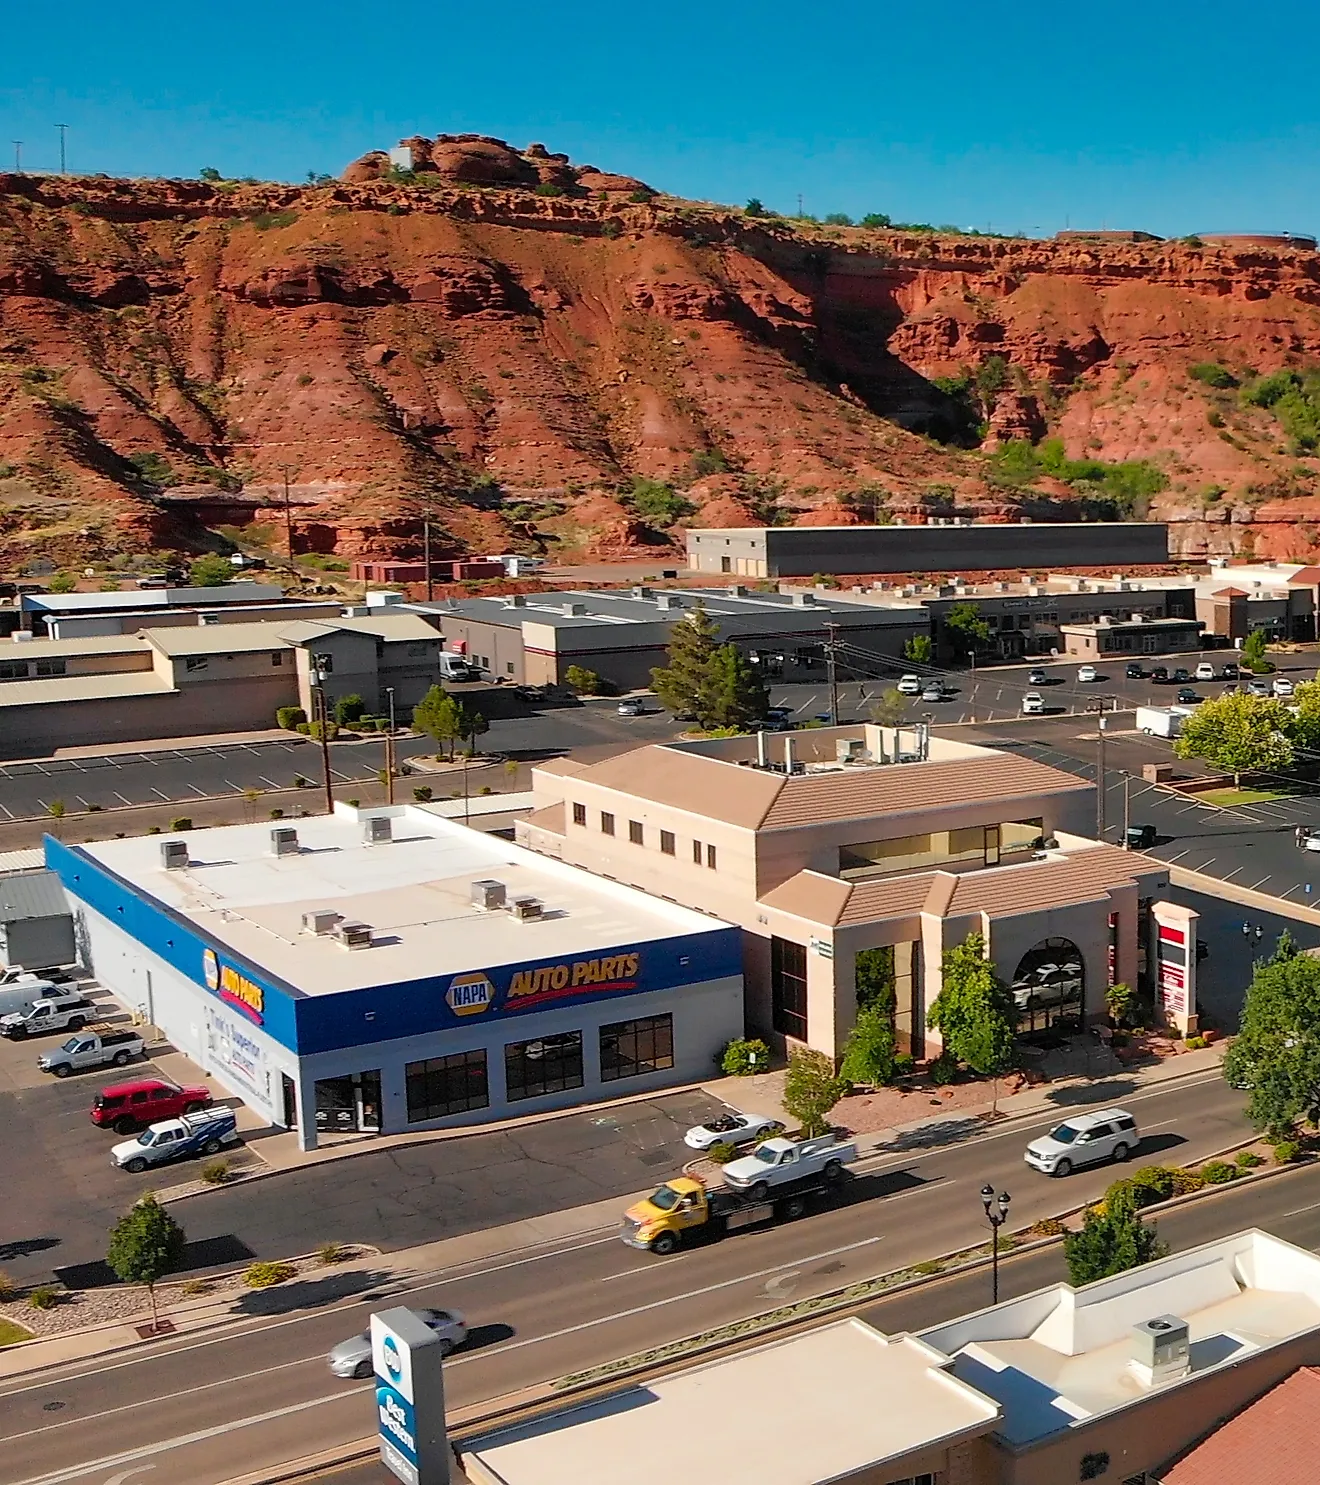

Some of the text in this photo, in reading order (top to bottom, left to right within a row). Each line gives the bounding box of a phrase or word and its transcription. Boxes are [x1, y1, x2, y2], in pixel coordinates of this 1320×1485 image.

[221, 965, 240, 997] AUTO
[239, 975, 263, 1012] PARTS
[453, 984, 487, 1006] NAPA
[507, 952, 640, 998] AUTO PARTS
[379, 1405, 416, 1454] Western
[386, 1394, 406, 1426] Best
